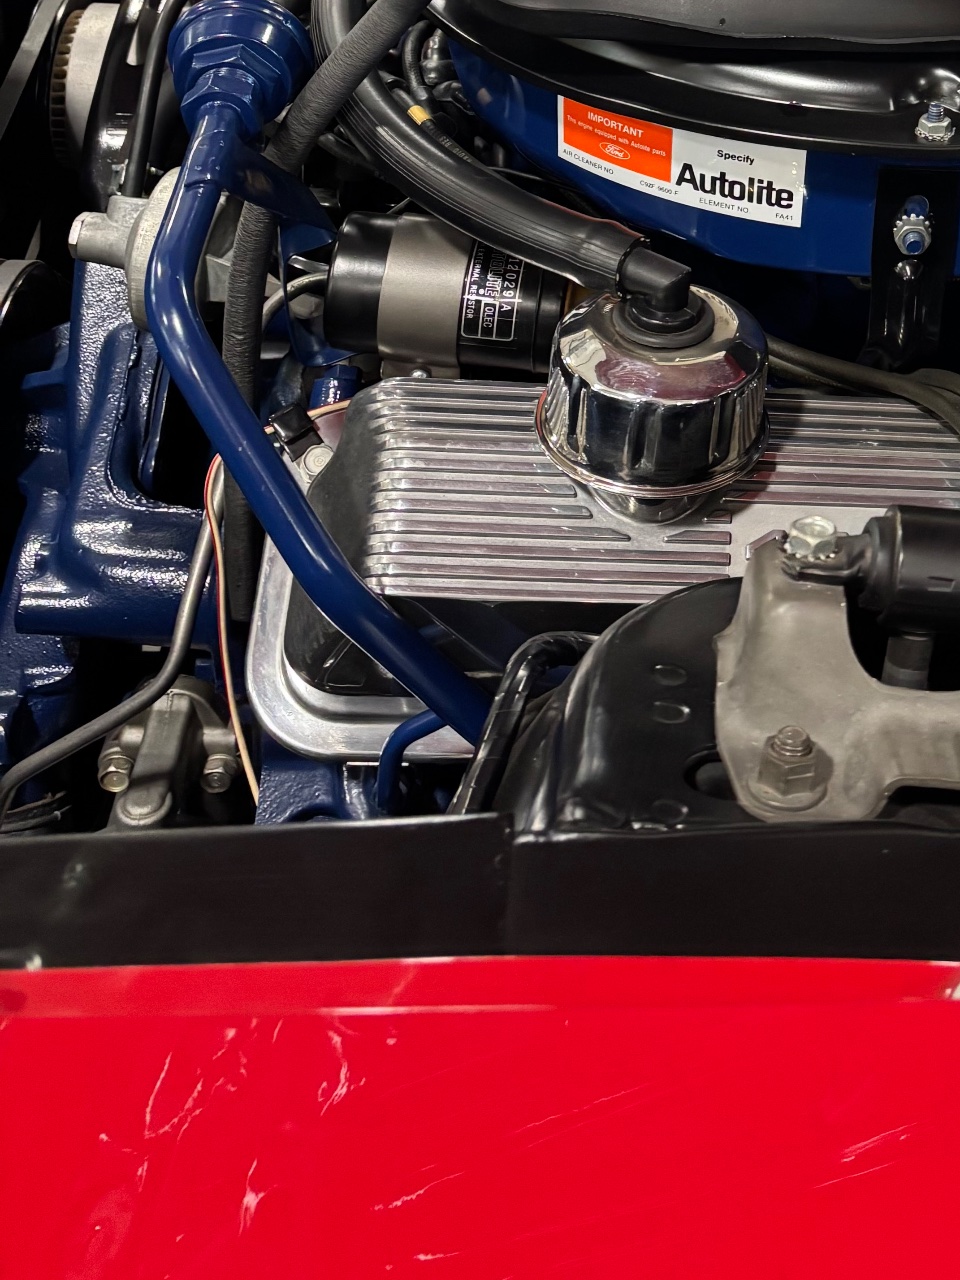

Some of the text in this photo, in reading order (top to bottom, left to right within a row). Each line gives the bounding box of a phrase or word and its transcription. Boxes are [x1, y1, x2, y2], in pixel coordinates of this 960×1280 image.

[567, 115, 667, 157] This engine equipped with Autolite parts
[588, 111, 644, 138] IMPORTANT
[563, 148, 573, 157] AIR
[573, 152, 603, 170] CLEANER
[716, 149, 755, 166] Specify
[675, 162, 794, 209] Autolite
[699, 197, 736, 211] ELEMENT
[775, 213, 794, 221] FA41
[471, 248, 485, 281] EXTERNAL
[484, 246, 506, 297] TOLITE
[466, 285, 478, 319] RESSTOR
[483, 306, 495, 328] OLEC
